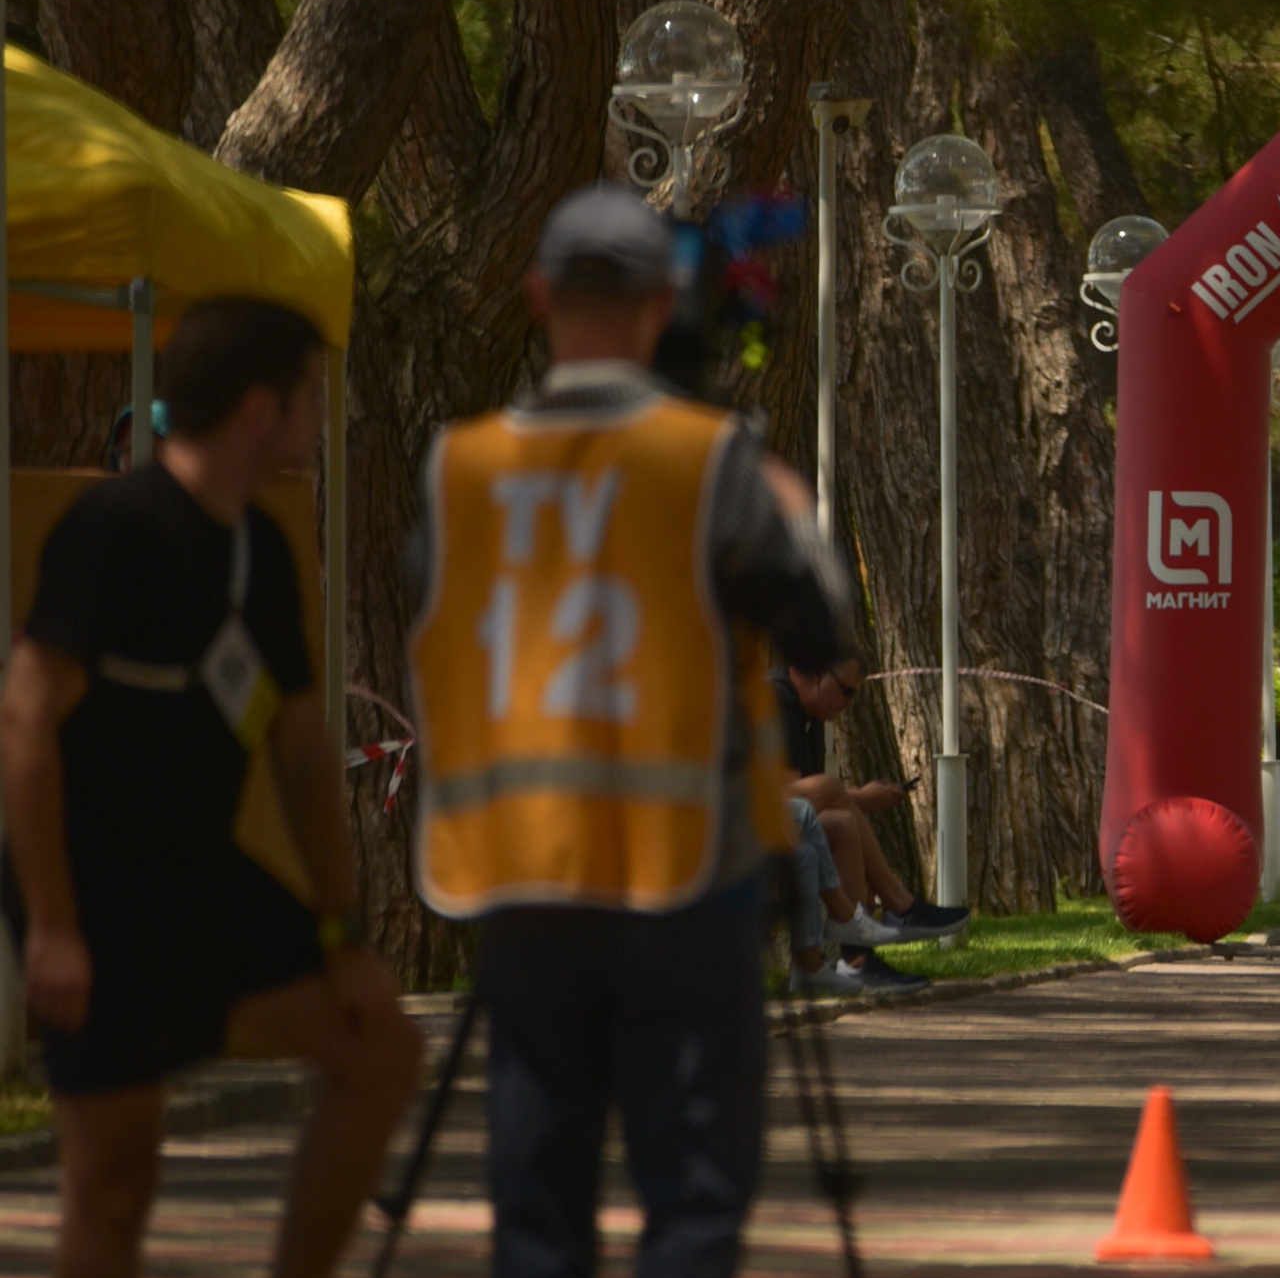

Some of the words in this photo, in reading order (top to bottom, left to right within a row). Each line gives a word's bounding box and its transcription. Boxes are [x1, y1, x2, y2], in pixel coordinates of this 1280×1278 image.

[491, 465, 623, 566] TV
[476, 573, 641, 723] 12
[1146, 591, 1231, 609] МАГНИТ
